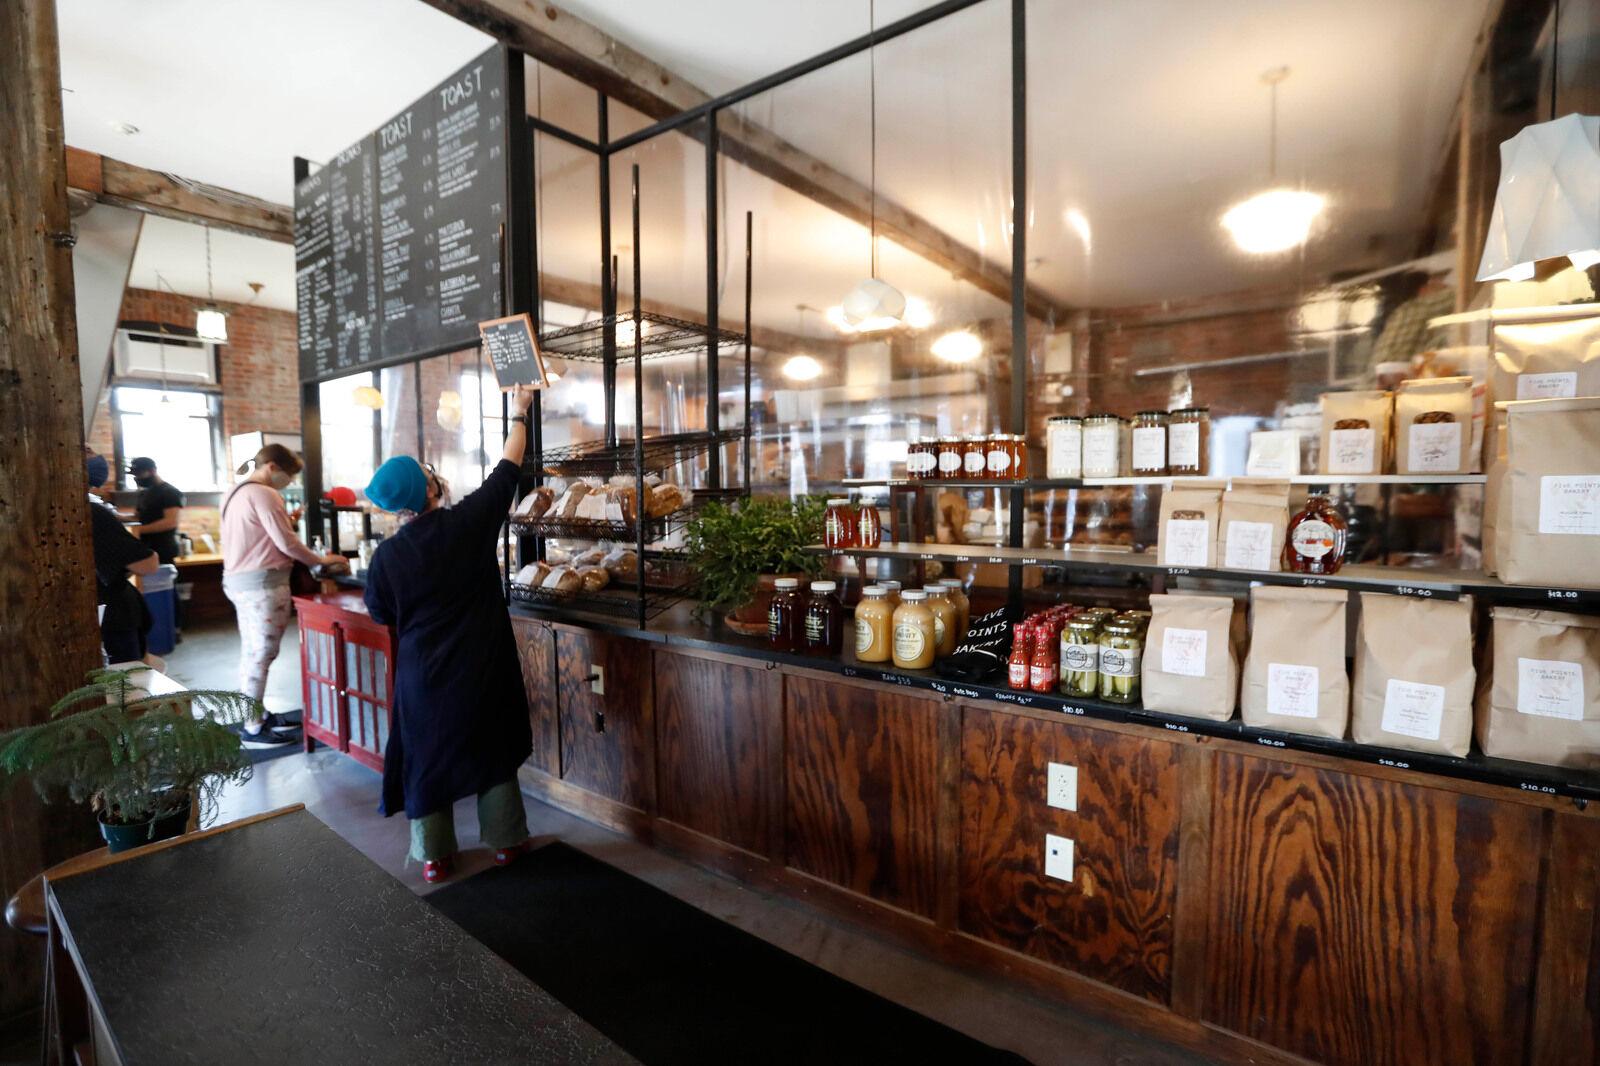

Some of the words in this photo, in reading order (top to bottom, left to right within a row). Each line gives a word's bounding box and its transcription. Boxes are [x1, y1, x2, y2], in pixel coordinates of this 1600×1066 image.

[440, 65, 483, 112] TOAST
[381, 112, 413, 149] TOAST
[1397, 586, 1433, 597] $10.00
[1548, 589, 1578, 599] $12.00
[974, 607, 1005, 624] IVE
[966, 620, 1008, 638] OINTS
[1063, 704, 1085, 715] $10.00
[1165, 723, 1188, 732] $10.00
[1257, 737, 1286, 747] $10.00
[1379, 758, 1410, 769] $10.00
[1521, 782, 1556, 794] $10.00
